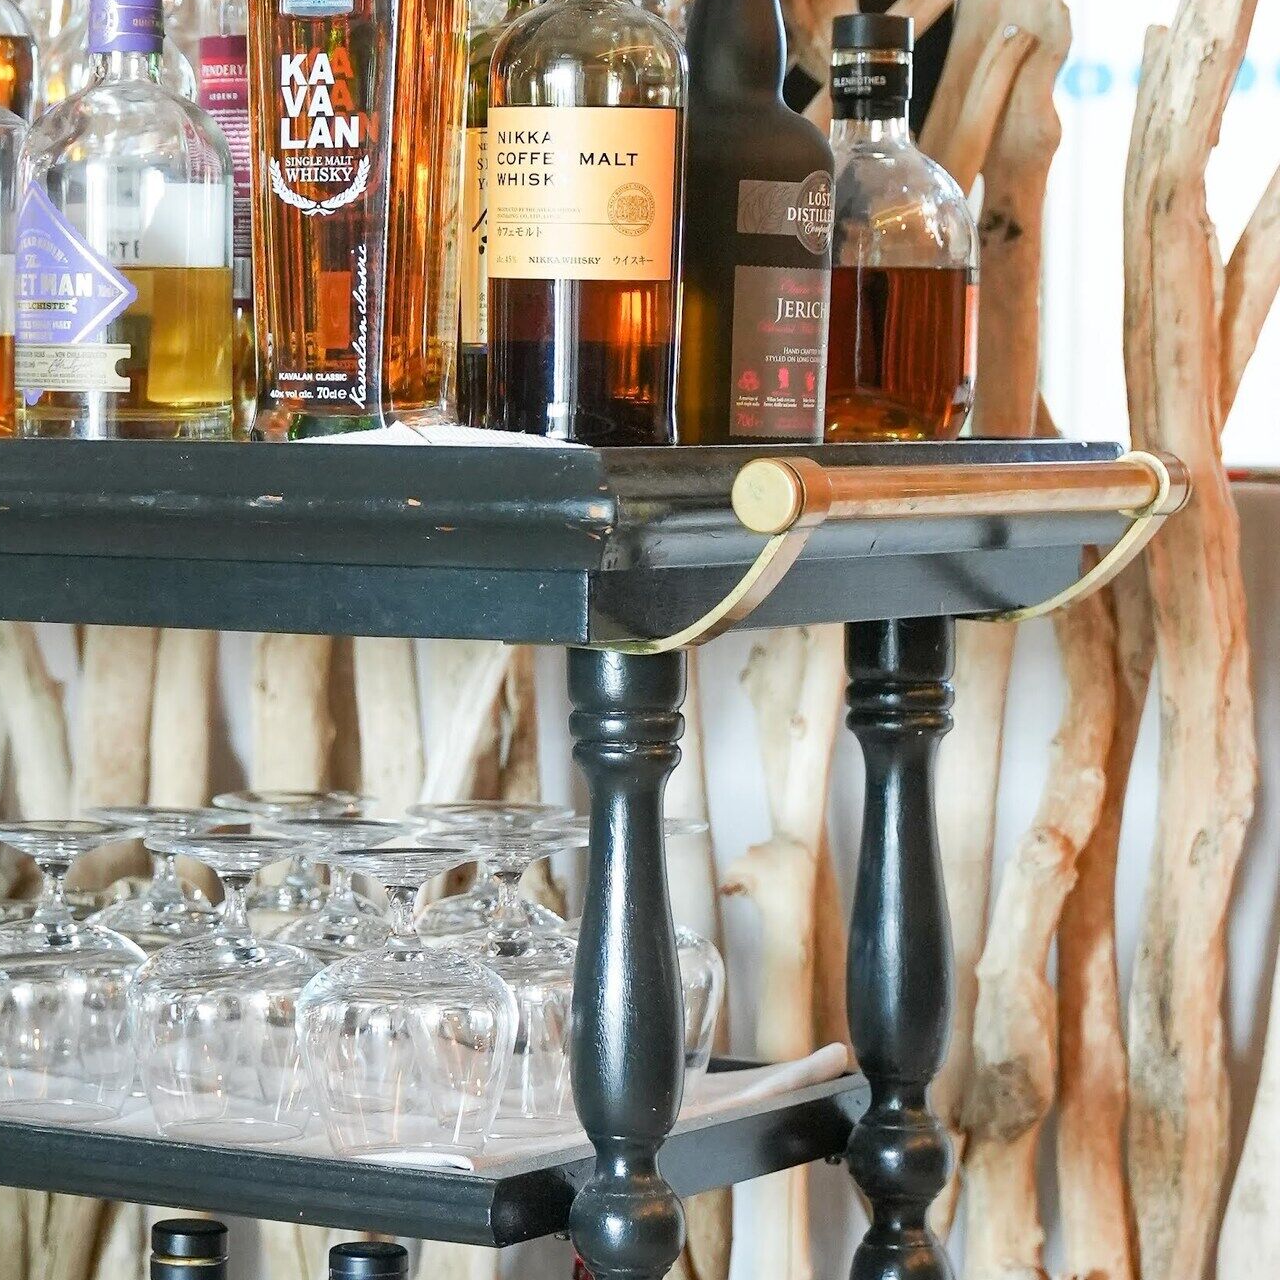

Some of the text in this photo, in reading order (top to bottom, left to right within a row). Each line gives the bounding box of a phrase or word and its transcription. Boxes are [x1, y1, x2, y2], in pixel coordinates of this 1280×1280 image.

[280, 116, 360, 150] LAN
[497, 131, 554, 144] NIKKA
[285, 156, 354, 167] SINGLE MALT
[497, 152, 639, 167] COFFE MALT
[285, 167, 354, 183] WHISKY
[497, 173, 556, 186] WHISK
[40, 272, 93, 298] MAN
[278, 372, 348, 382] KAVALAN CLASSIC
[285, 388, 298, 400] vol
[299, 389, 315, 399] alc.
[316, 386, 337, 400] 70cl
